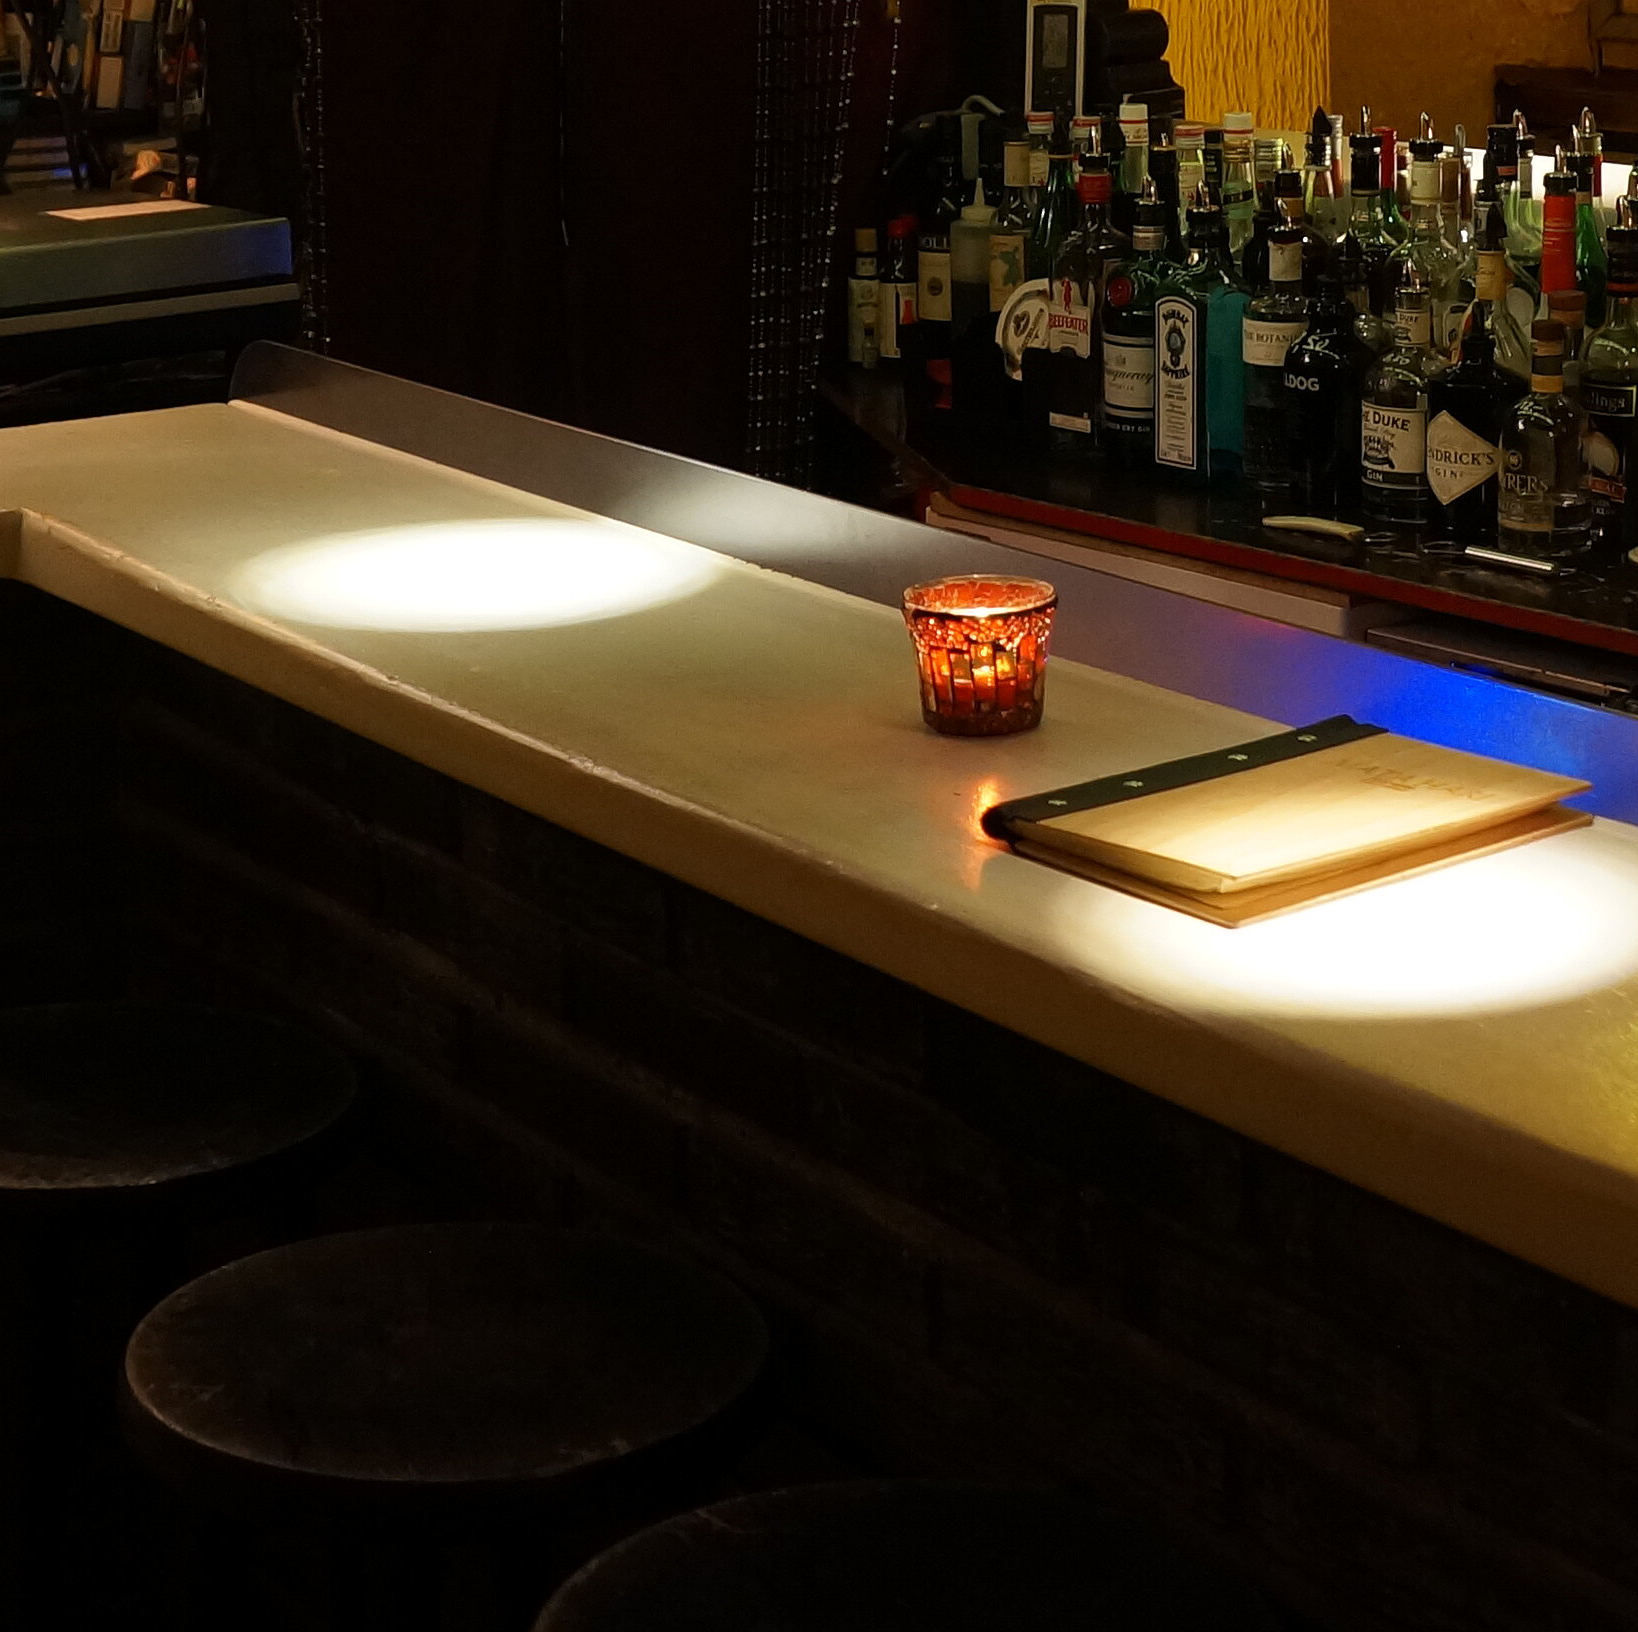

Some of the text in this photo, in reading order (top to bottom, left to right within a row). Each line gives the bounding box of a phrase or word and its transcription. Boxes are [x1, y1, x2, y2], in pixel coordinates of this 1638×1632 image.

[1048, 312, 1089, 336] BEEFEATER
[1255, 332, 1299, 345] BOTANI
[1284, 372, 1321, 392] LDOG
[1590, 390, 1627, 412] lings
[1373, 410, 1412, 432] DUKE
